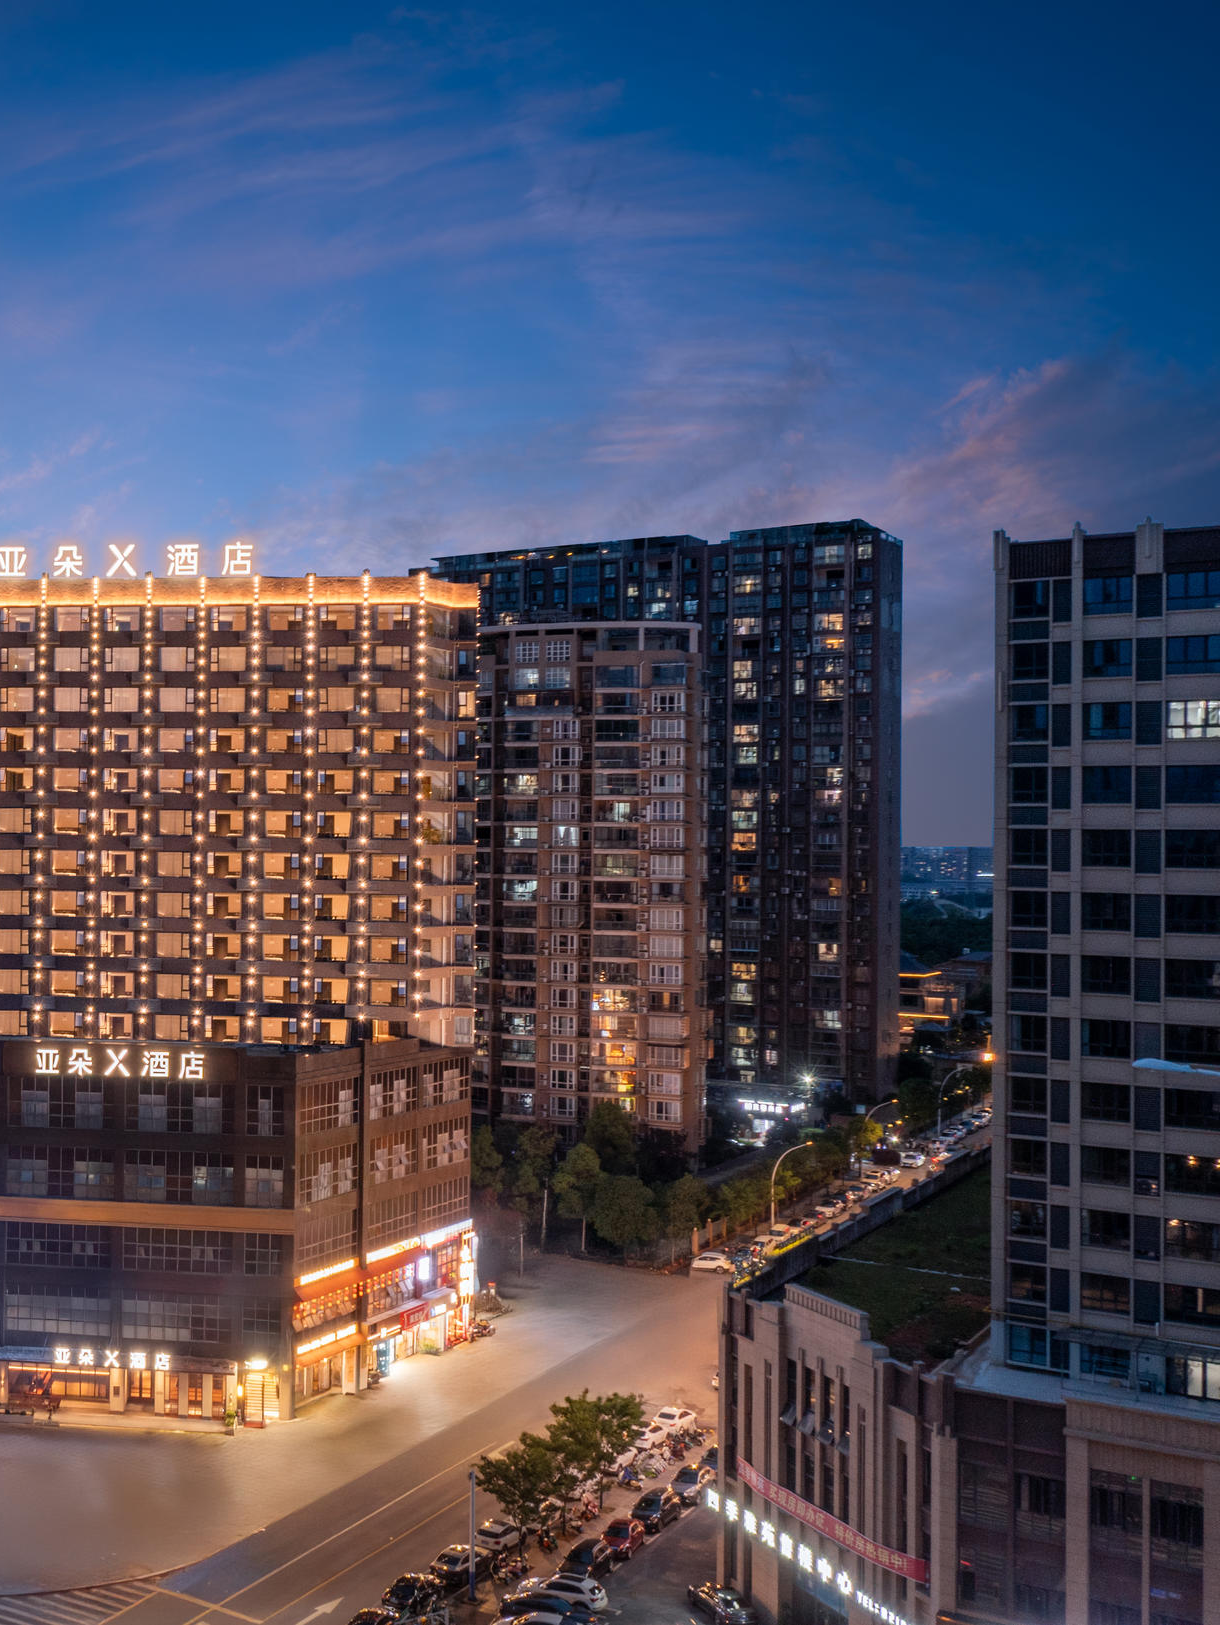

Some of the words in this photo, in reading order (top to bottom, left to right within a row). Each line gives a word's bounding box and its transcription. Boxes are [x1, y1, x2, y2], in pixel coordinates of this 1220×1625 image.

[34, 1048, 206, 1080] 亚朵X酒店
[54, 1347, 172, 1371] 亚朵X酒店
